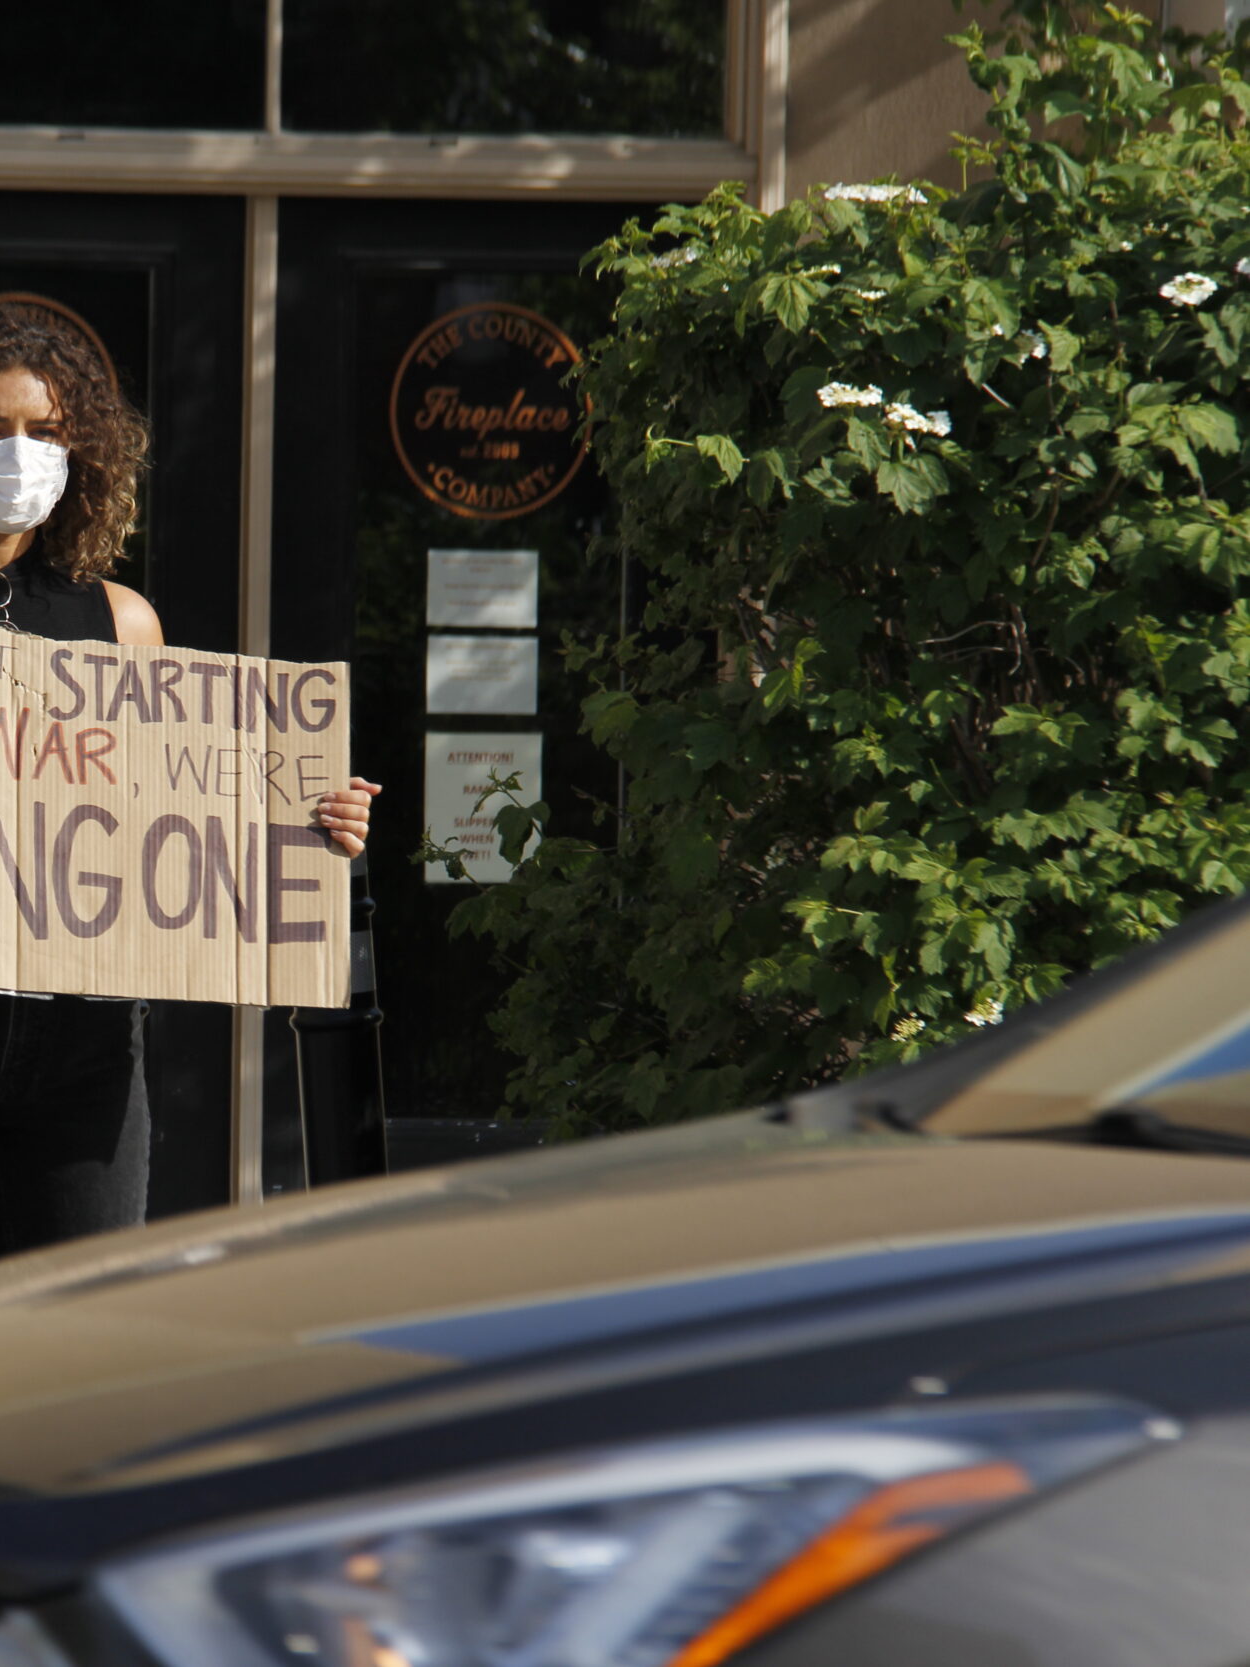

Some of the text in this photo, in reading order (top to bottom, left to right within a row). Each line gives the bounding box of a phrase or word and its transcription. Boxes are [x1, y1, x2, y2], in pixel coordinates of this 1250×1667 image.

[416, 315, 567, 368] THE COUNTY
[414, 386, 570, 441] Fireplace
[433, 465, 552, 508] COMPANY
[48, 648, 337, 733] STARTING
[165, 743, 330, 806] WE'RE
[447, 751, 514, 765] ATTENTION!
[459, 833, 495, 844] WHEN
[142, 814, 332, 945] ONE
